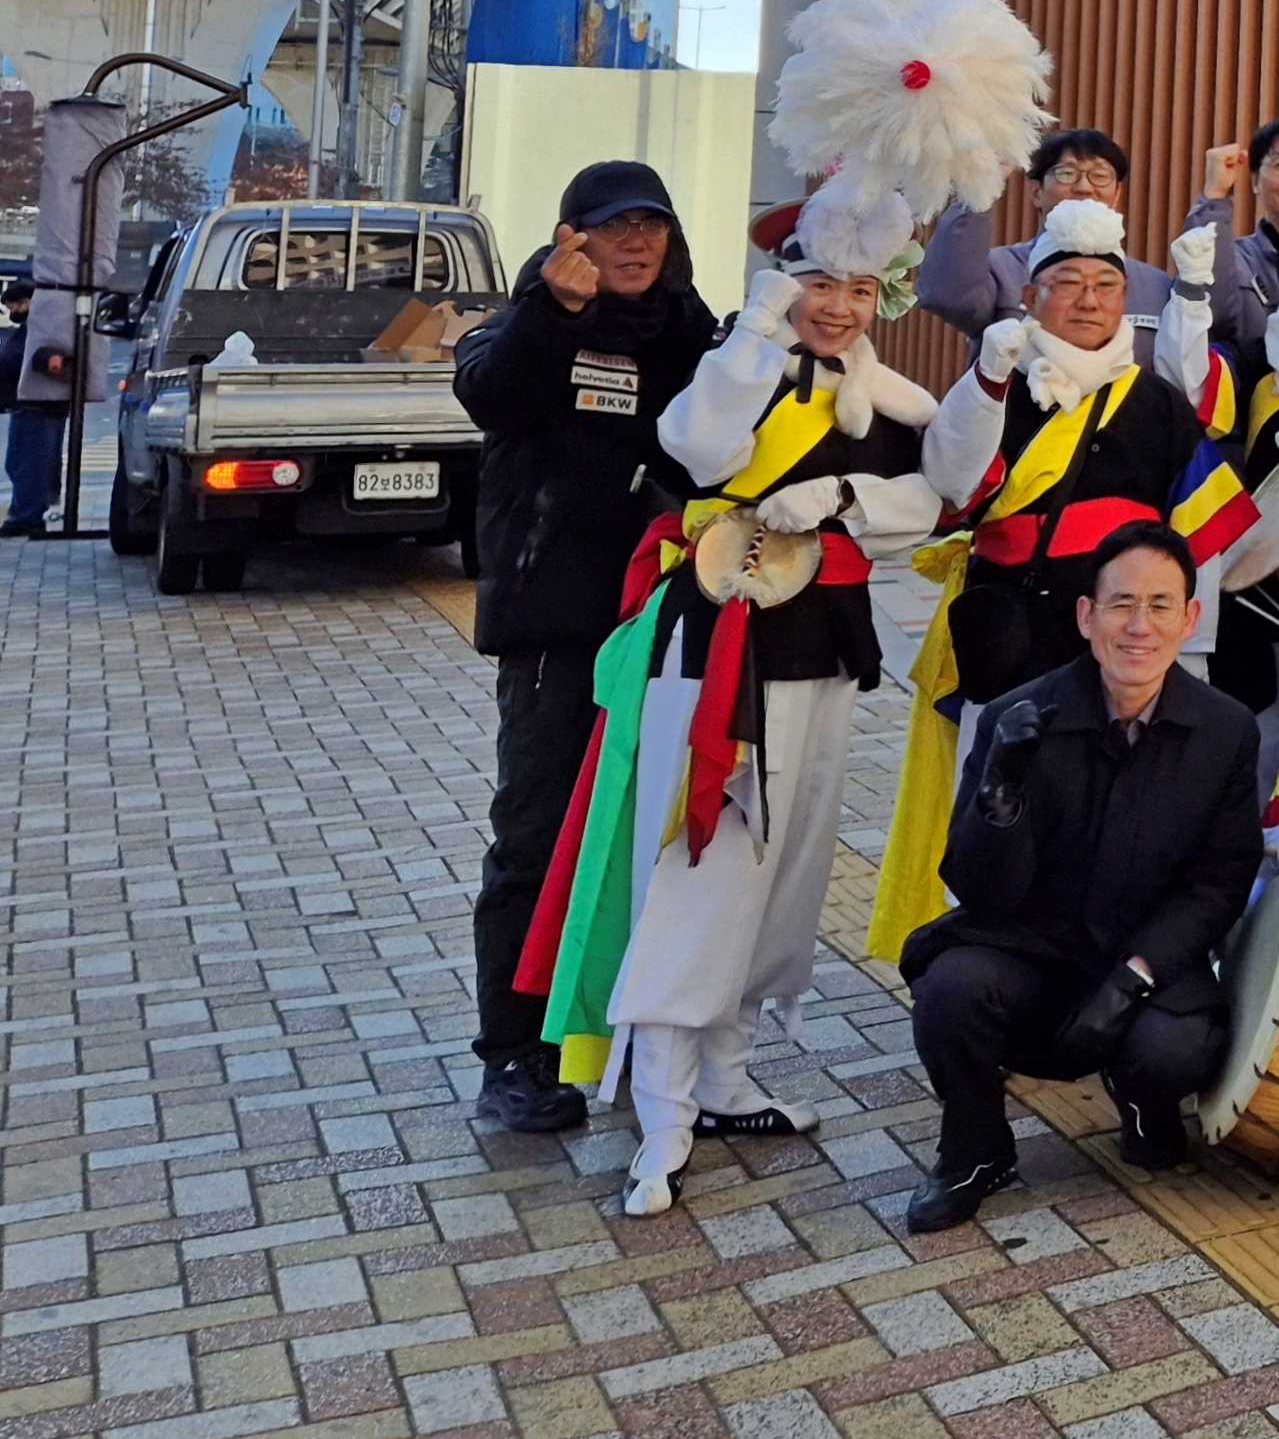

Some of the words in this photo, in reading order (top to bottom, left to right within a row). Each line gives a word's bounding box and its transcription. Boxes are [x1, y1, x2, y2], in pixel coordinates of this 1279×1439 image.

[574, 371, 620, 386] helvetia
[596, 395, 632, 410] BKW
[358, 473, 435, 492] 82보8383
